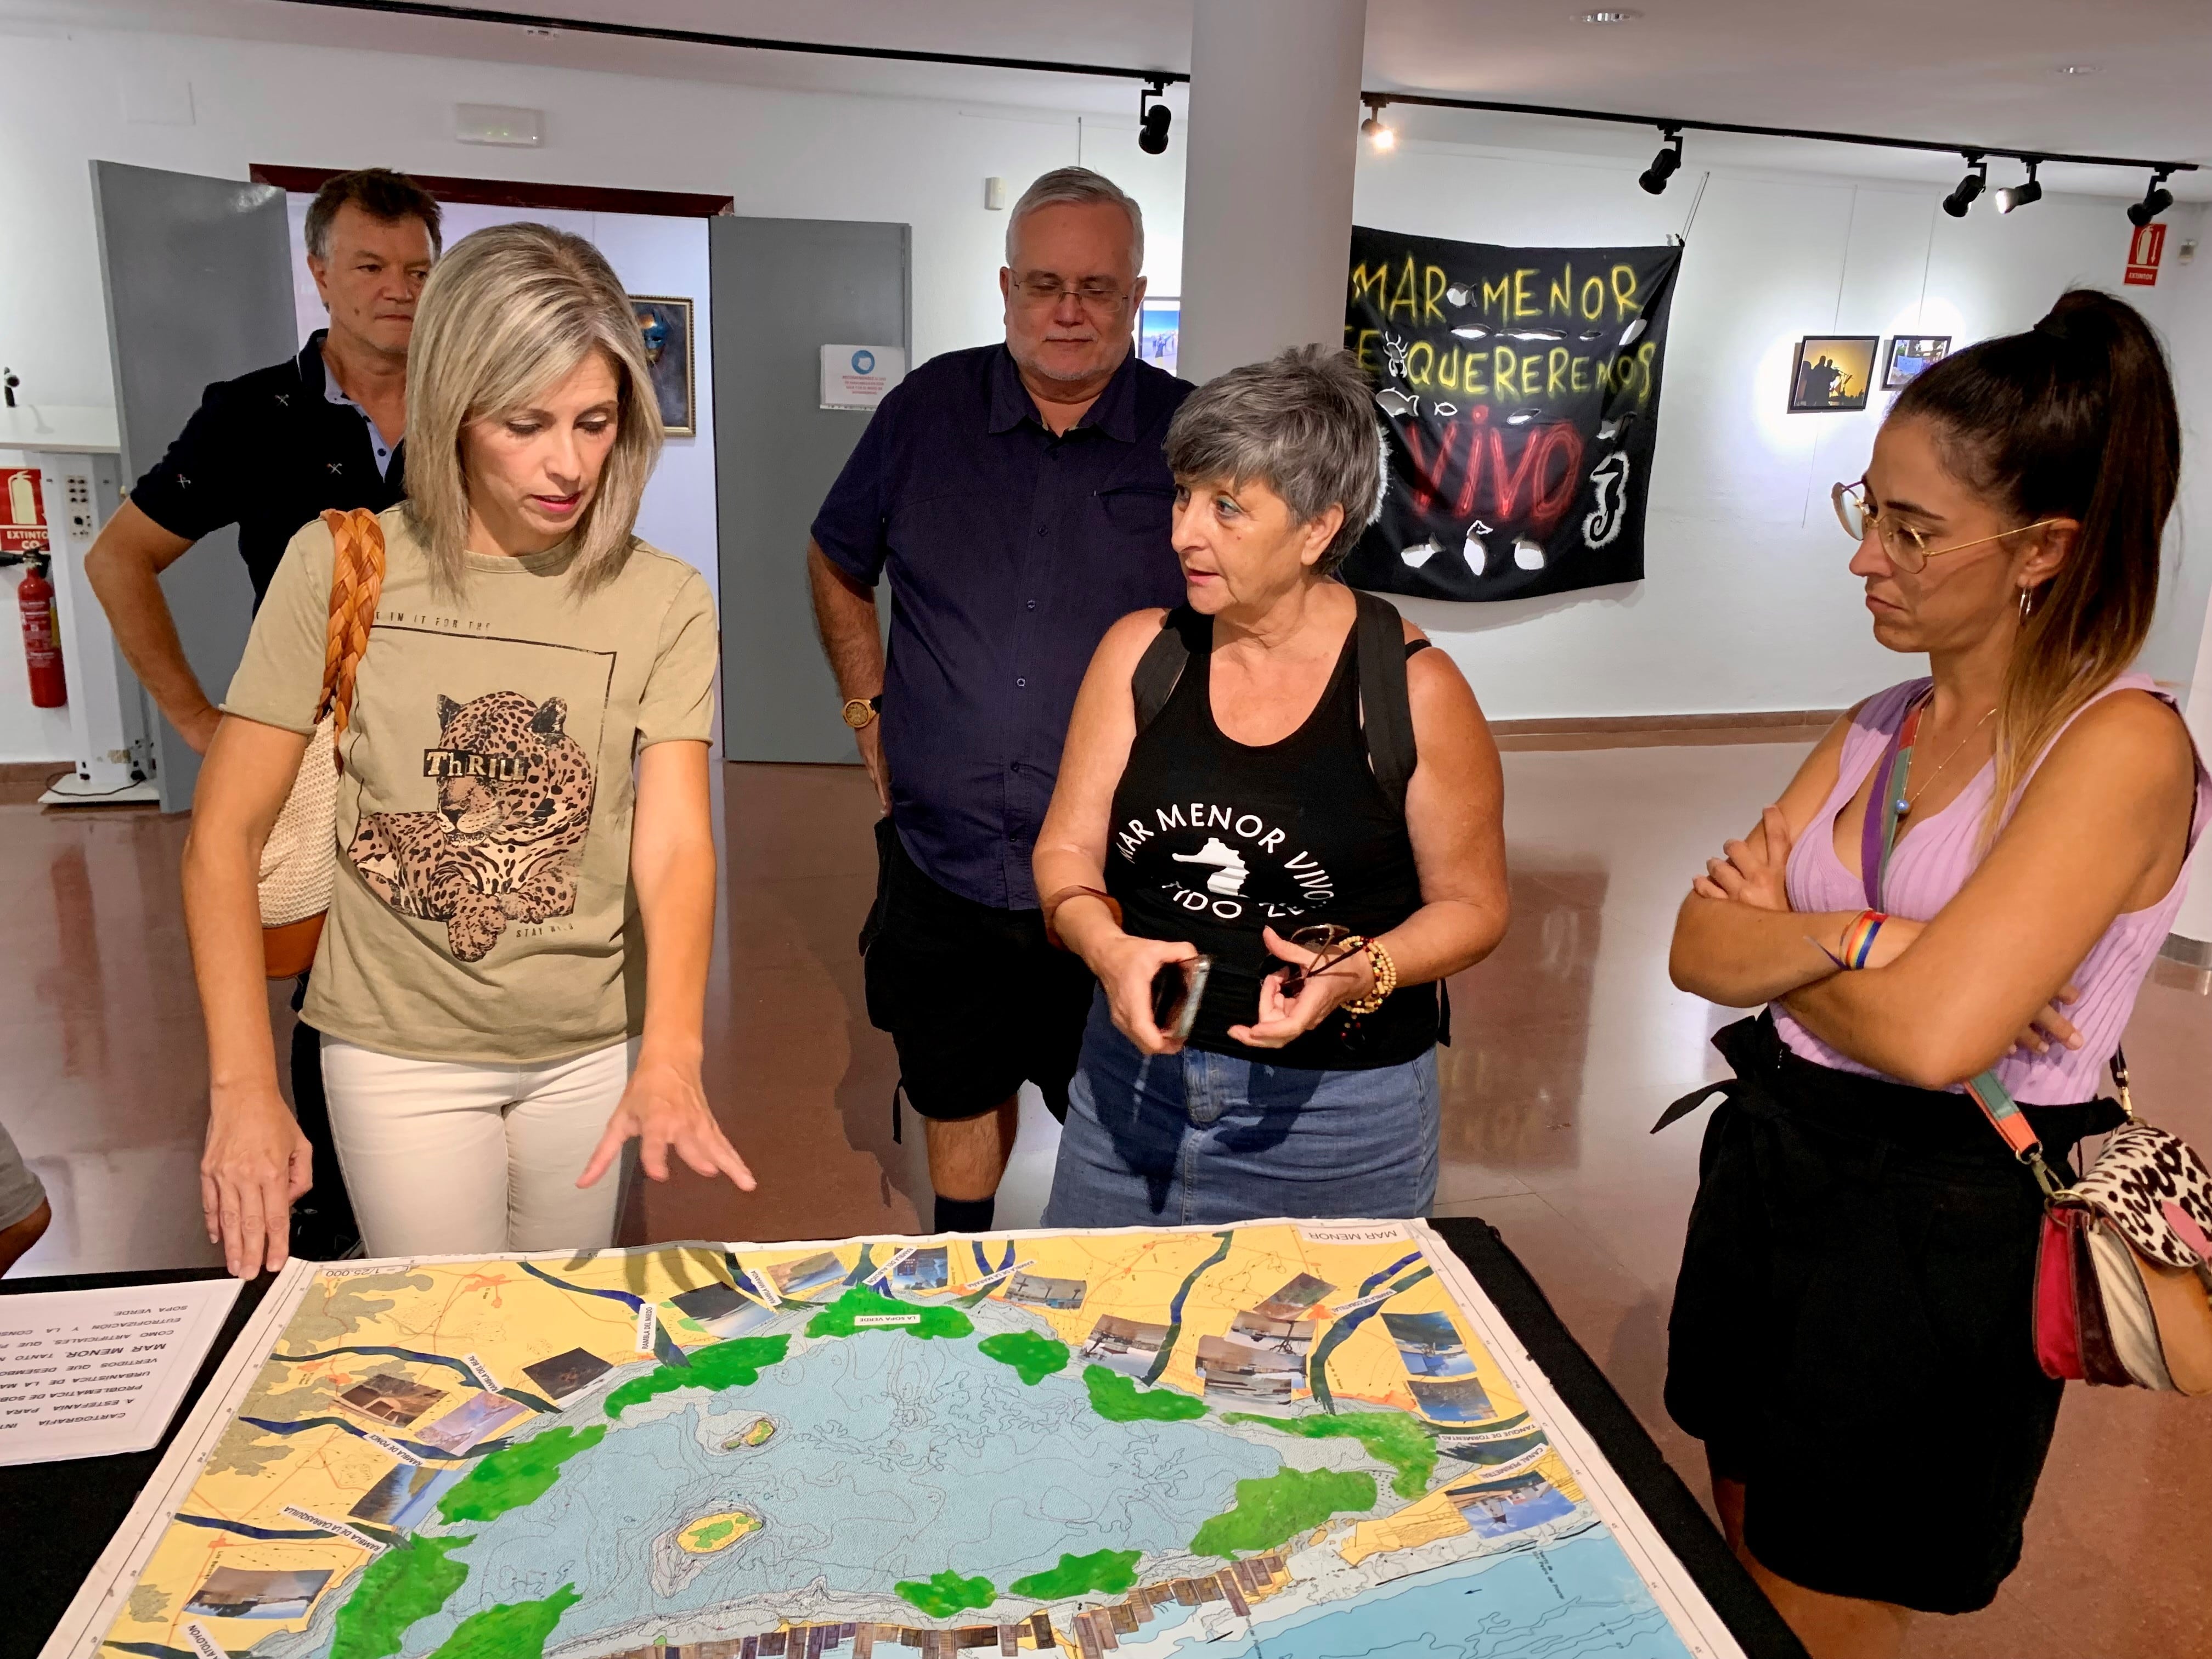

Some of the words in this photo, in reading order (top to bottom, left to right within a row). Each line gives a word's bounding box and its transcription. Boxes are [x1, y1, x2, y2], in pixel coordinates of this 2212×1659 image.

[1352, 253, 1447, 325] MAR
[1483, 262, 1643, 326] MENOR
[1407, 341, 1656, 407] QUEREREMOS
[7, 531, 48, 539] EXTINTO
[390, 612, 404, 622] IN
[435, 617, 458, 628] FOR
[1116, 819, 1154, 864] MAR
[1156, 803, 1285, 853] MENOR
[1284, 851, 1334, 900] VIVO
[516, 927, 542, 938] STAY
[1365, 1230, 1397, 1239] MAR
[326, 1268, 380, 1277] 1/25.000
[131, 1343, 166, 1352] MAR
[100, 1358, 157, 1368] VERTIDOS
[481, 1373, 499, 1392] RAMBLA
[7, 1407, 40, 1415] PARA
[1504, 1423, 1536, 1437] TANQUE
[1523, 1447, 1543, 1463] CANAL
[284, 1506, 332, 1528] CARRASQUILLA
[351, 1534, 381, 1551] RAMBLA
